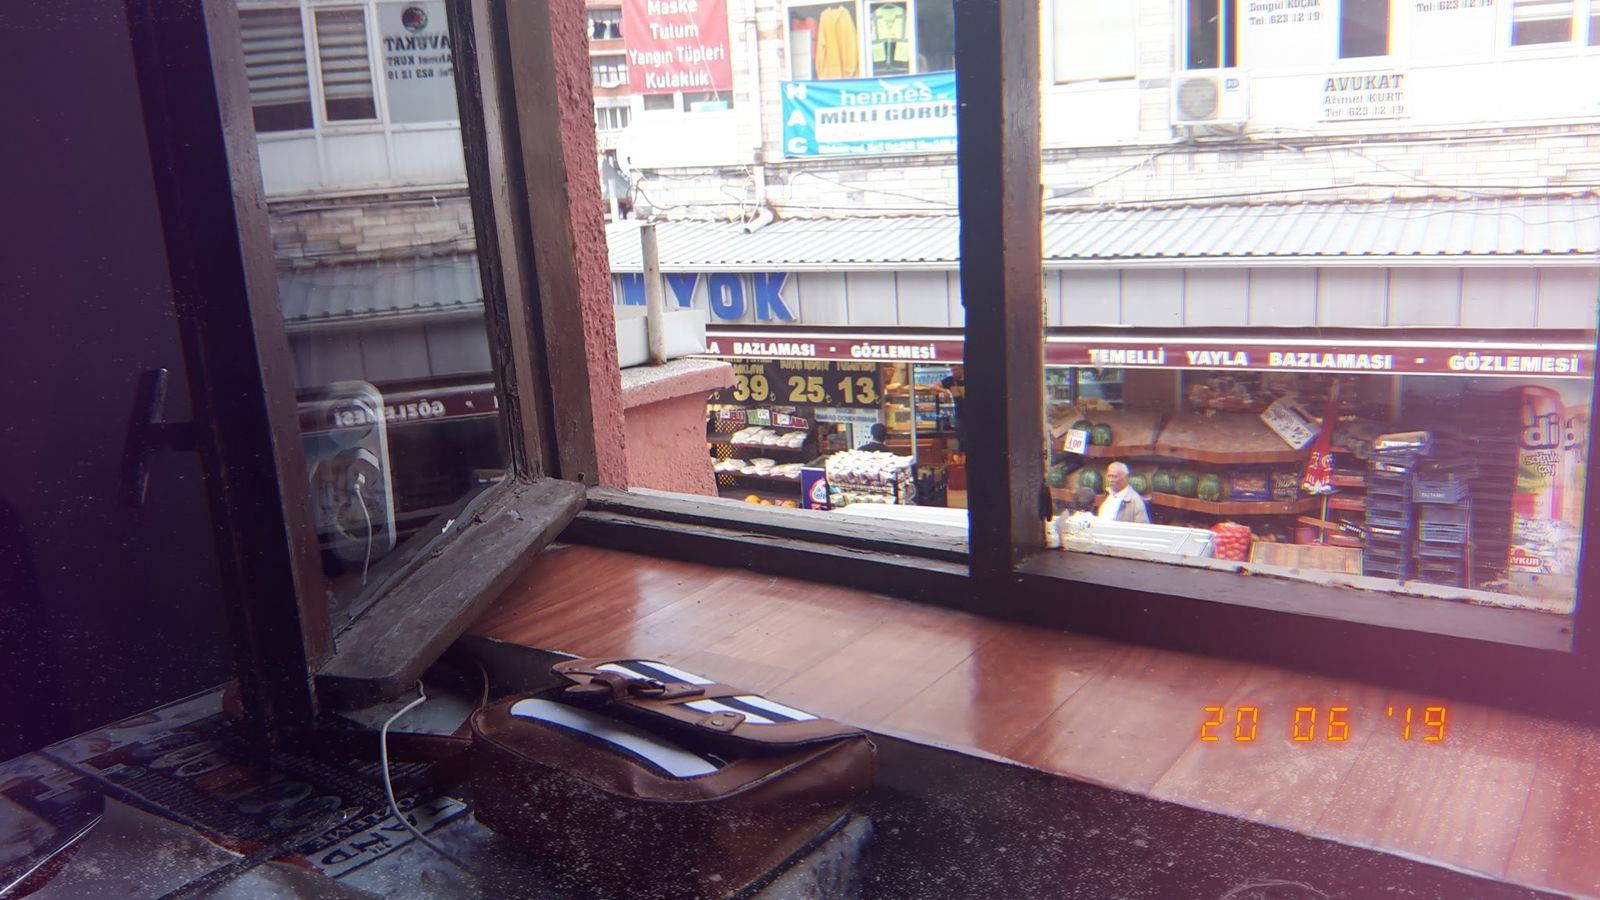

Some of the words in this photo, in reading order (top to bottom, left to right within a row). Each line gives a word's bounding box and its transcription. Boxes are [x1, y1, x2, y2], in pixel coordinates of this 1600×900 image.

[648, 0, 697, 13] Maske
[650, 23, 698, 40] Tulum
[630, 49, 673, 66] Yangın
[677, 43, 724, 64] Tüpleri
[645, 70, 709, 89] Kulaklık
[1323, 74, 1404, 92] AVUKAT
[1348, 106, 1368, 116] 623
[733, 342, 815, 357] BAZLAMASI
[851, 342, 936, 360] GÖZLEMESİ
[1088, 347, 1166, 364] TEMELLİ
[1186, 350, 1249, 366] YAYLA
[1269, 352, 1393, 370] BAZLAMASI
[1448, 352, 1580, 373] GÖZLEMESİ
